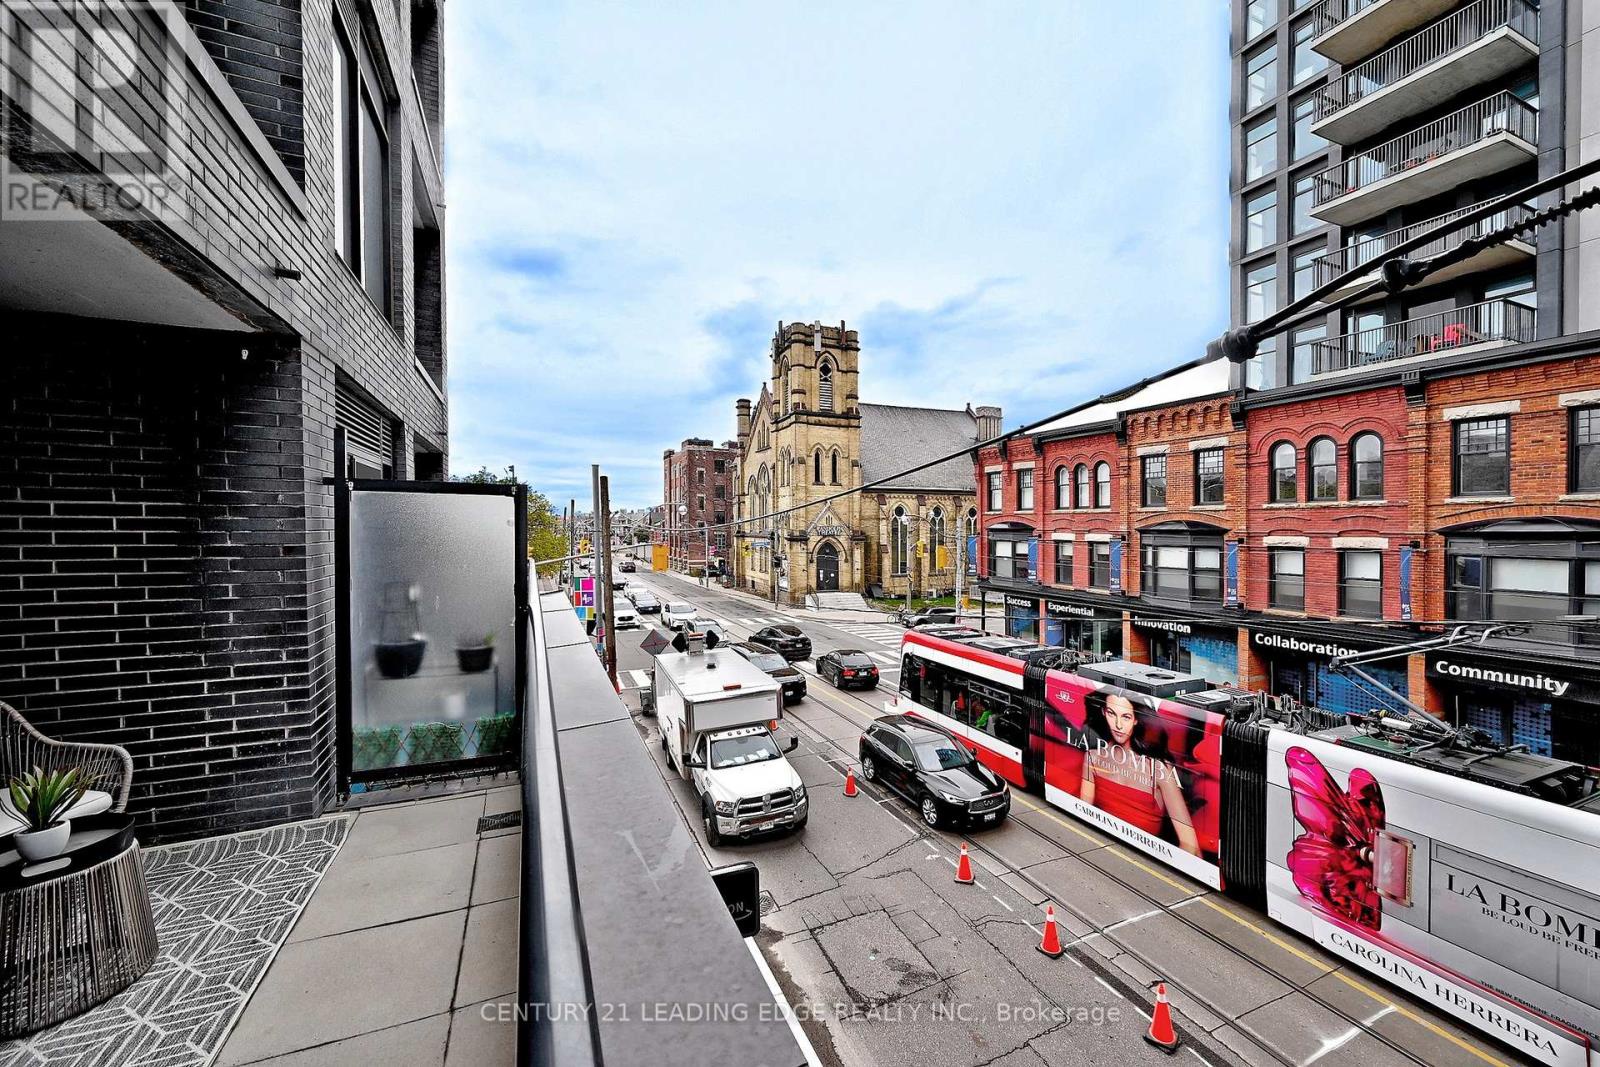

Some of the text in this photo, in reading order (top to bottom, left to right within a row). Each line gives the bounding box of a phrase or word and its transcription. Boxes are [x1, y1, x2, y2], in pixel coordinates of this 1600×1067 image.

[1006, 597, 1031, 608] Success
[1048, 602, 1094, 617] Experiential
[1134, 616, 1191, 634] Innovation
[1255, 633, 1358, 658] Collaboration
[1435, 660, 1569, 697] Community
[1065, 727, 1184, 790] LA BOMBA
[1074, 802, 1174, 859] CAROLINA HERRERA
[1446, 873, 1489, 906] LA
[1482, 907, 1498, 920] BE
[1502, 916, 1539, 935] LOUD
[1542, 931, 1561, 945] BE
[1331, 933, 1560, 1058] CAROLINA HERRERA
[1480, 980, 1495, 991] THE
